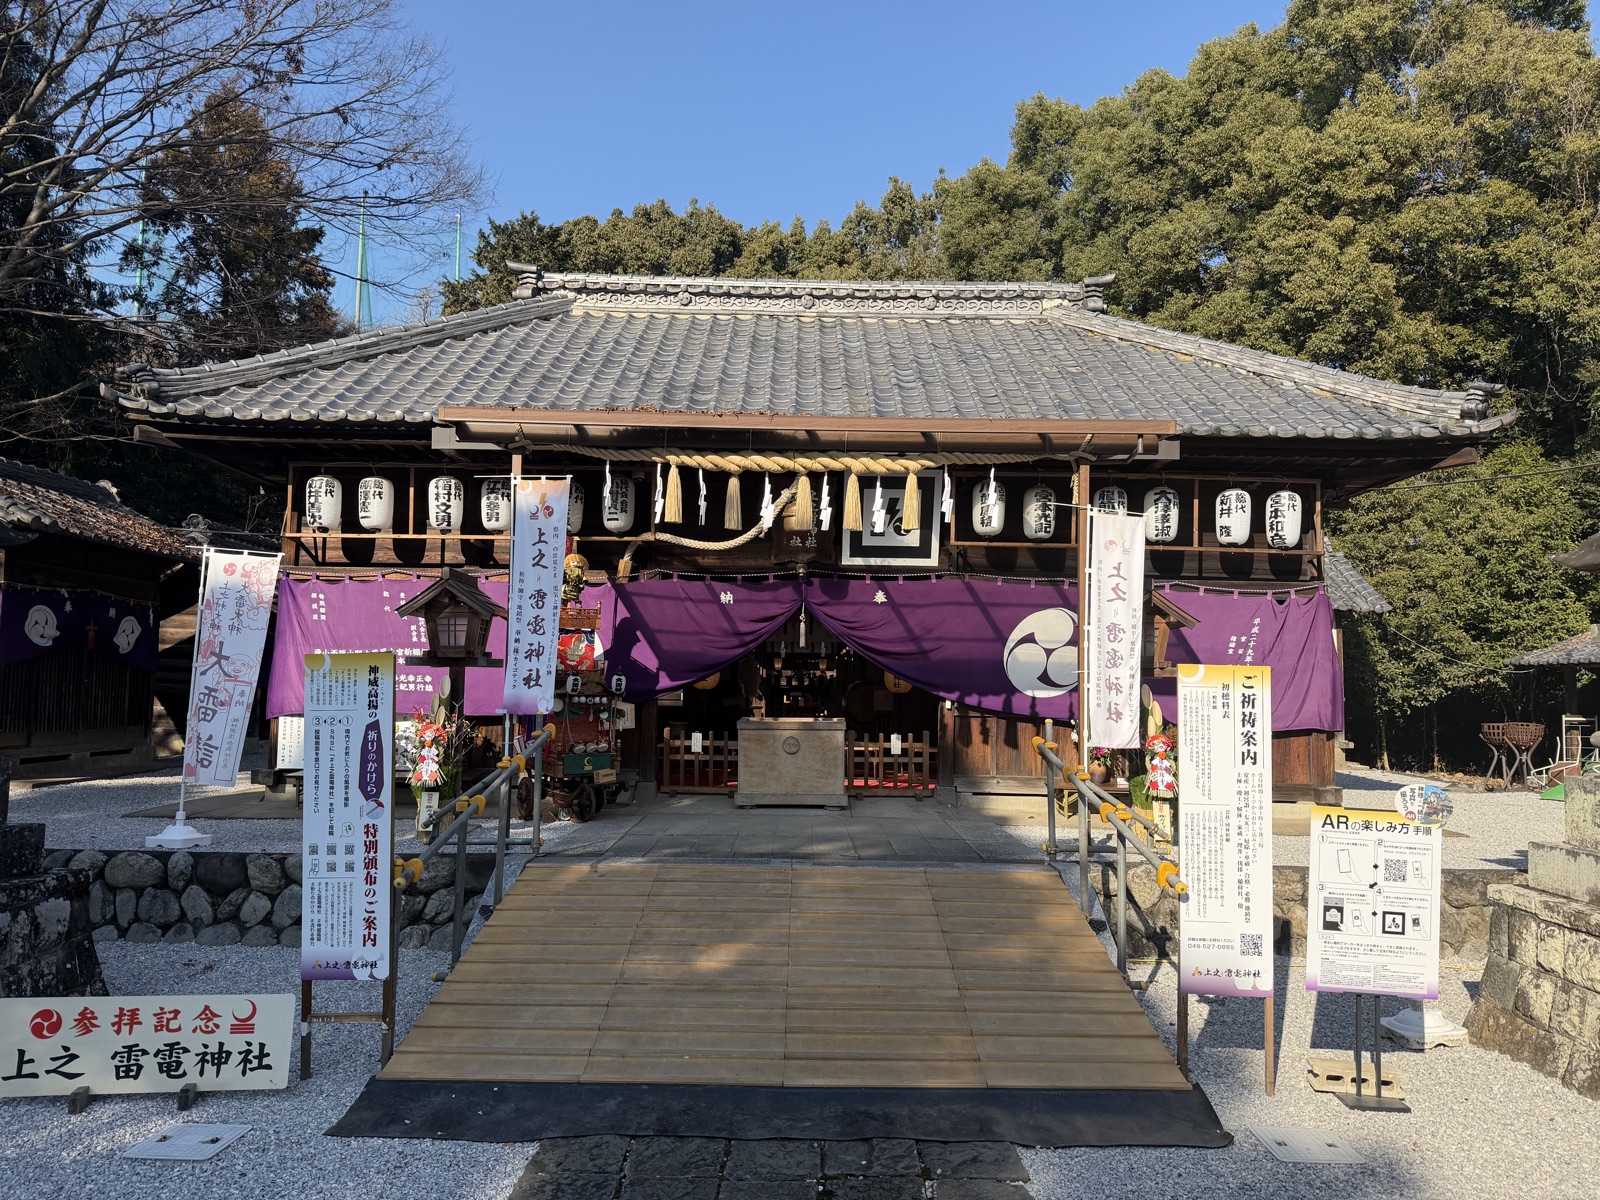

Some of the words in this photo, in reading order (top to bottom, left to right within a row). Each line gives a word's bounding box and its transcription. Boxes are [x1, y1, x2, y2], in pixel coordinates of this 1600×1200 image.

[325, 479, 335, 499] 総代
[373, 479, 384, 500] 総代
[453, 481, 462, 501] 総代
[434, 478, 452, 527] 稲村文男
[1219, 493, 1233, 518] 新井
[1234, 492, 1246, 514] 総代
[1287, 493, 1298, 512] 総代
[1219, 525, 1232, 538] 隆
[720, 591, 734, 604] 納
[873, 590, 888, 604] 奉
[1244, 617, 1261, 666] 平成二十九年
[367, 665, 379, 719] 神威高揚の
[1221, 683, 1231, 719] 初穂料表
[1240, 675, 1258, 766] ご祈祷案内
[366, 730, 378, 795] 祈りのかけら
[1321, 814, 1410, 835] ARの楽しみ方
[1412, 826, 1432, 837] 手順
[362, 823, 379, 947] 特別頒布のご案内
[68, 1004, 223, 1037] 参拝記念
[1, 1045, 86, 1082] 上之
[110, 1040, 273, 1081] 雷電神社
